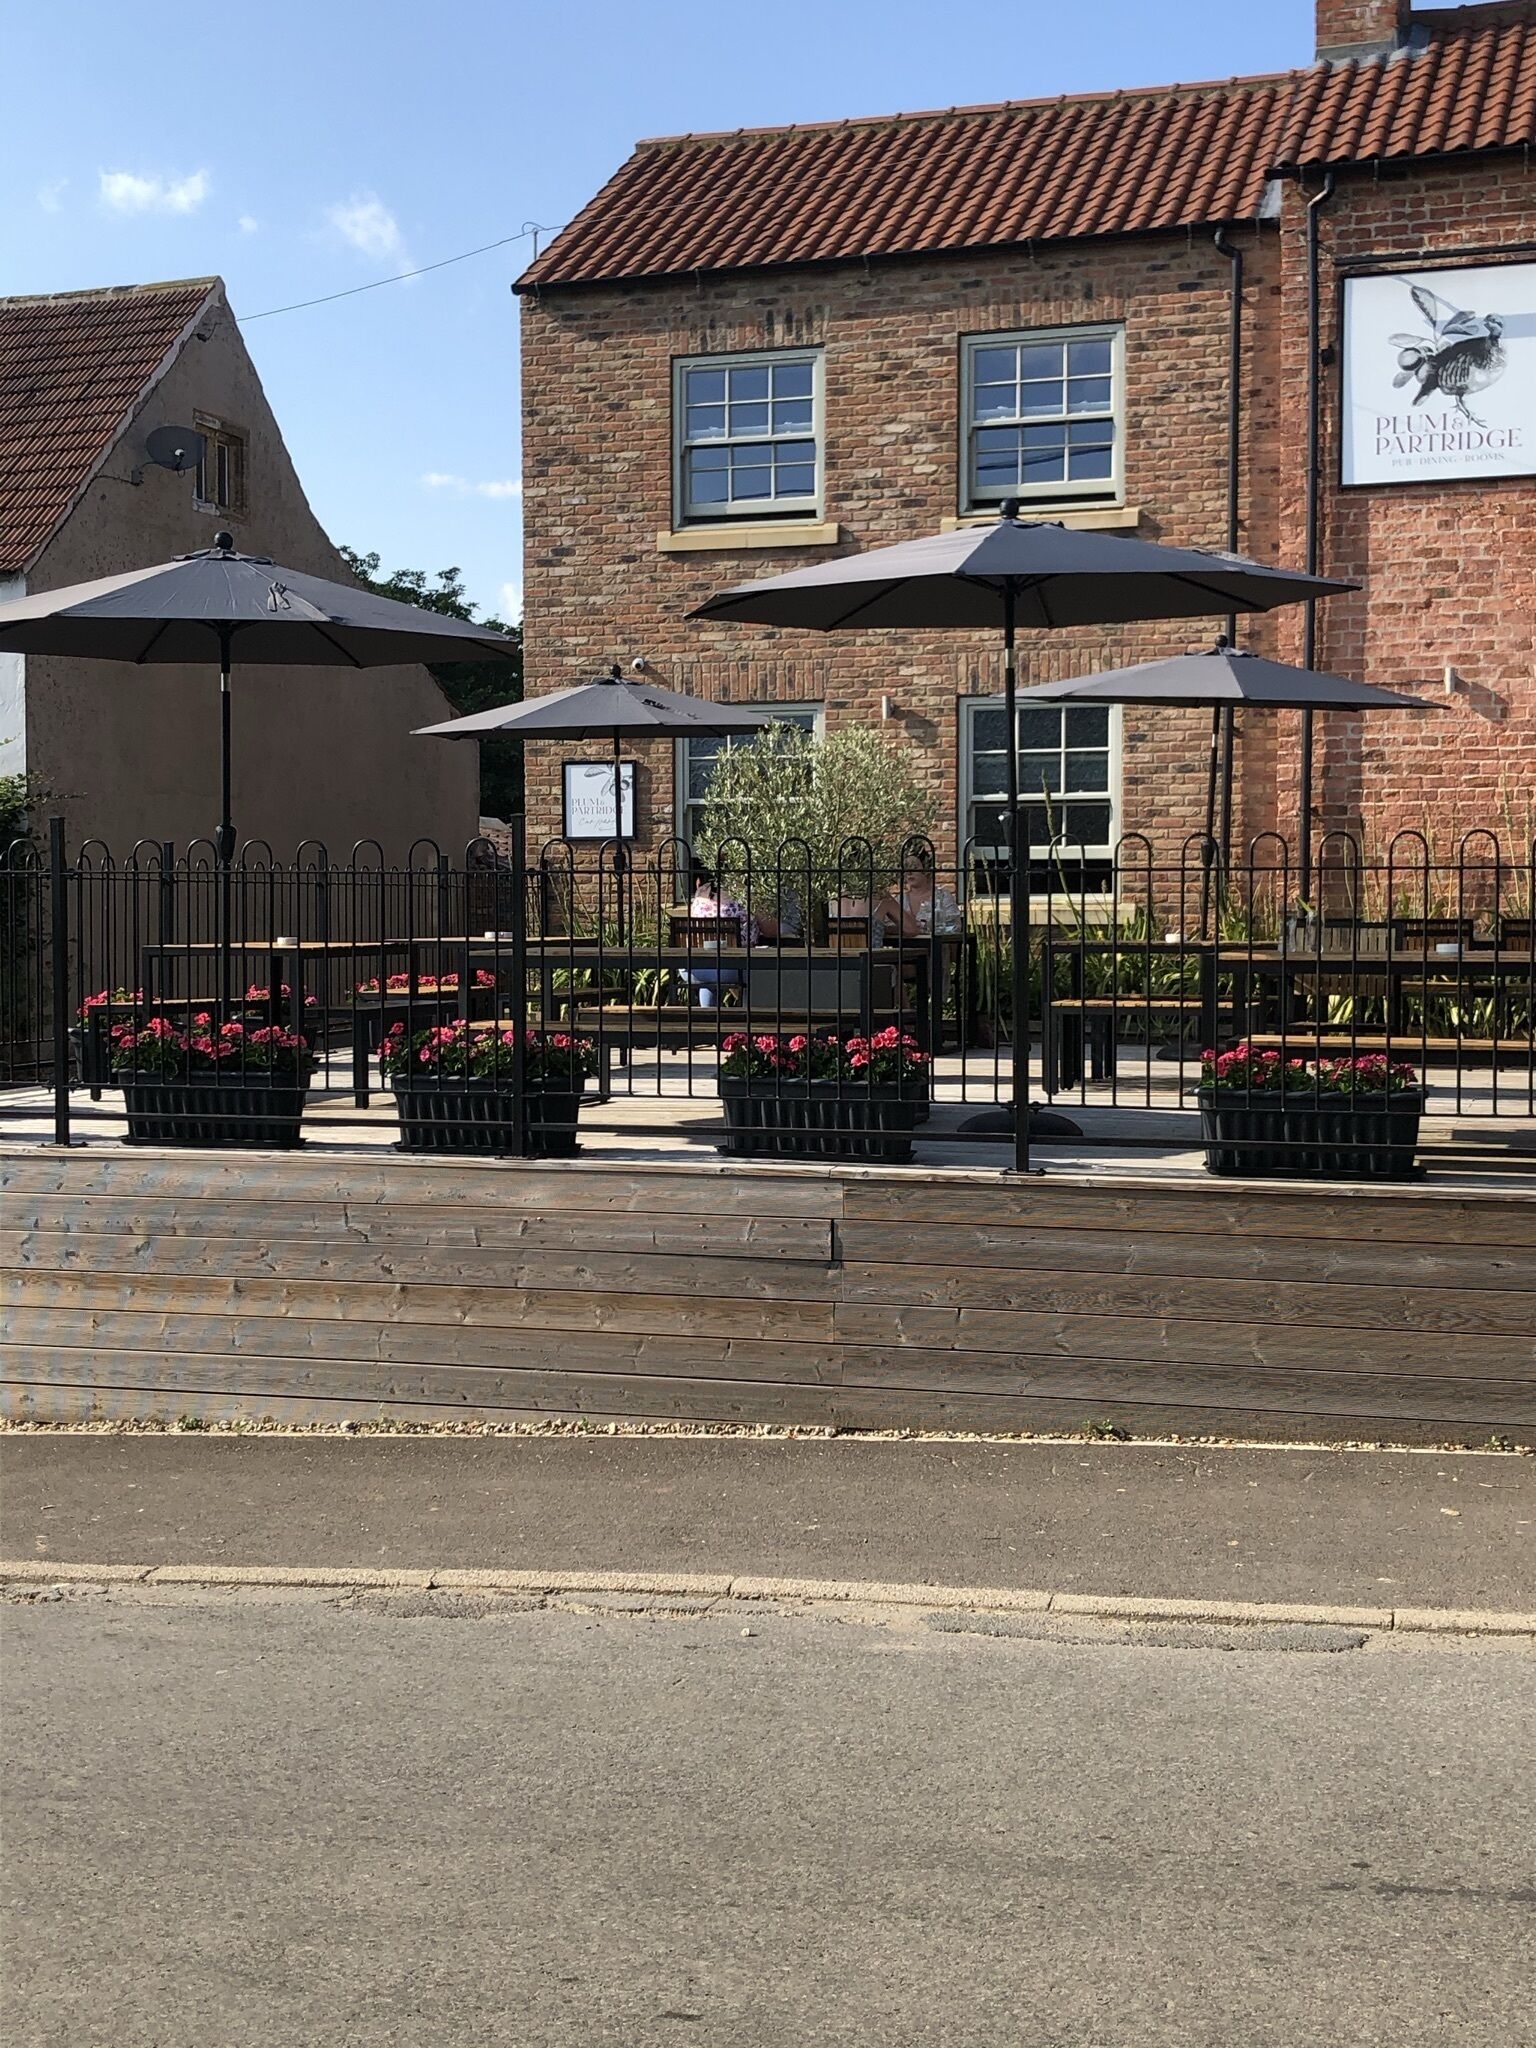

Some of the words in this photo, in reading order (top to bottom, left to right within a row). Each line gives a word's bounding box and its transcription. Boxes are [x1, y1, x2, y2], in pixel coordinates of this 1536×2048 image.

[1376, 427, 1523, 455] PARTRIDGE
[1419, 456, 1457, 466] DINING
[1464, 453, 1505, 463] ROOMS
